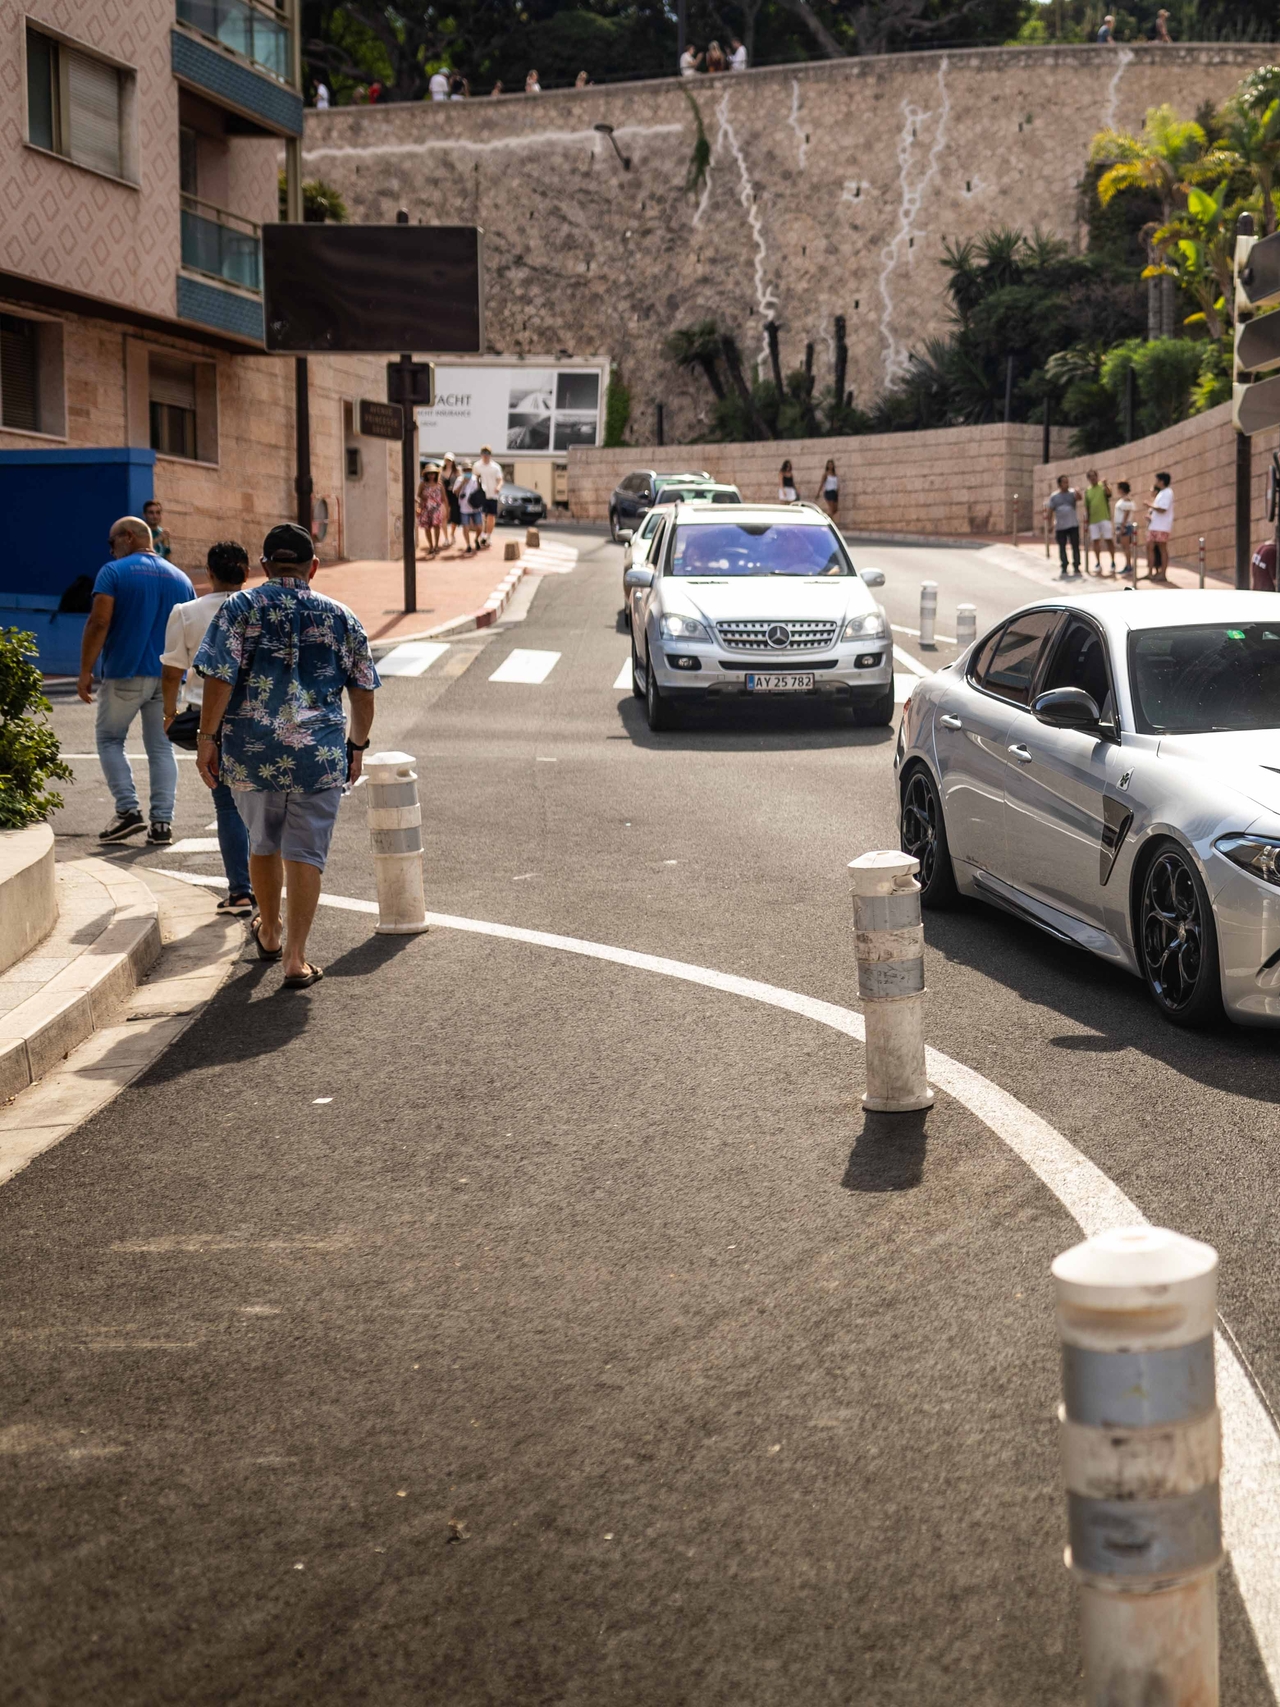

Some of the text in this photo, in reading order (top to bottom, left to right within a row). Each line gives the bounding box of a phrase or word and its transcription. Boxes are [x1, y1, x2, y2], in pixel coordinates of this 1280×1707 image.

[435, 394, 472, 406] ACHT
[370, 404, 392, 416] AVENUE
[364, 413, 398, 428] PRINCESSE
[756, 677, 771, 687] AY
[774, 676, 788, 687] 25
[791, 676, 811, 687] 782
